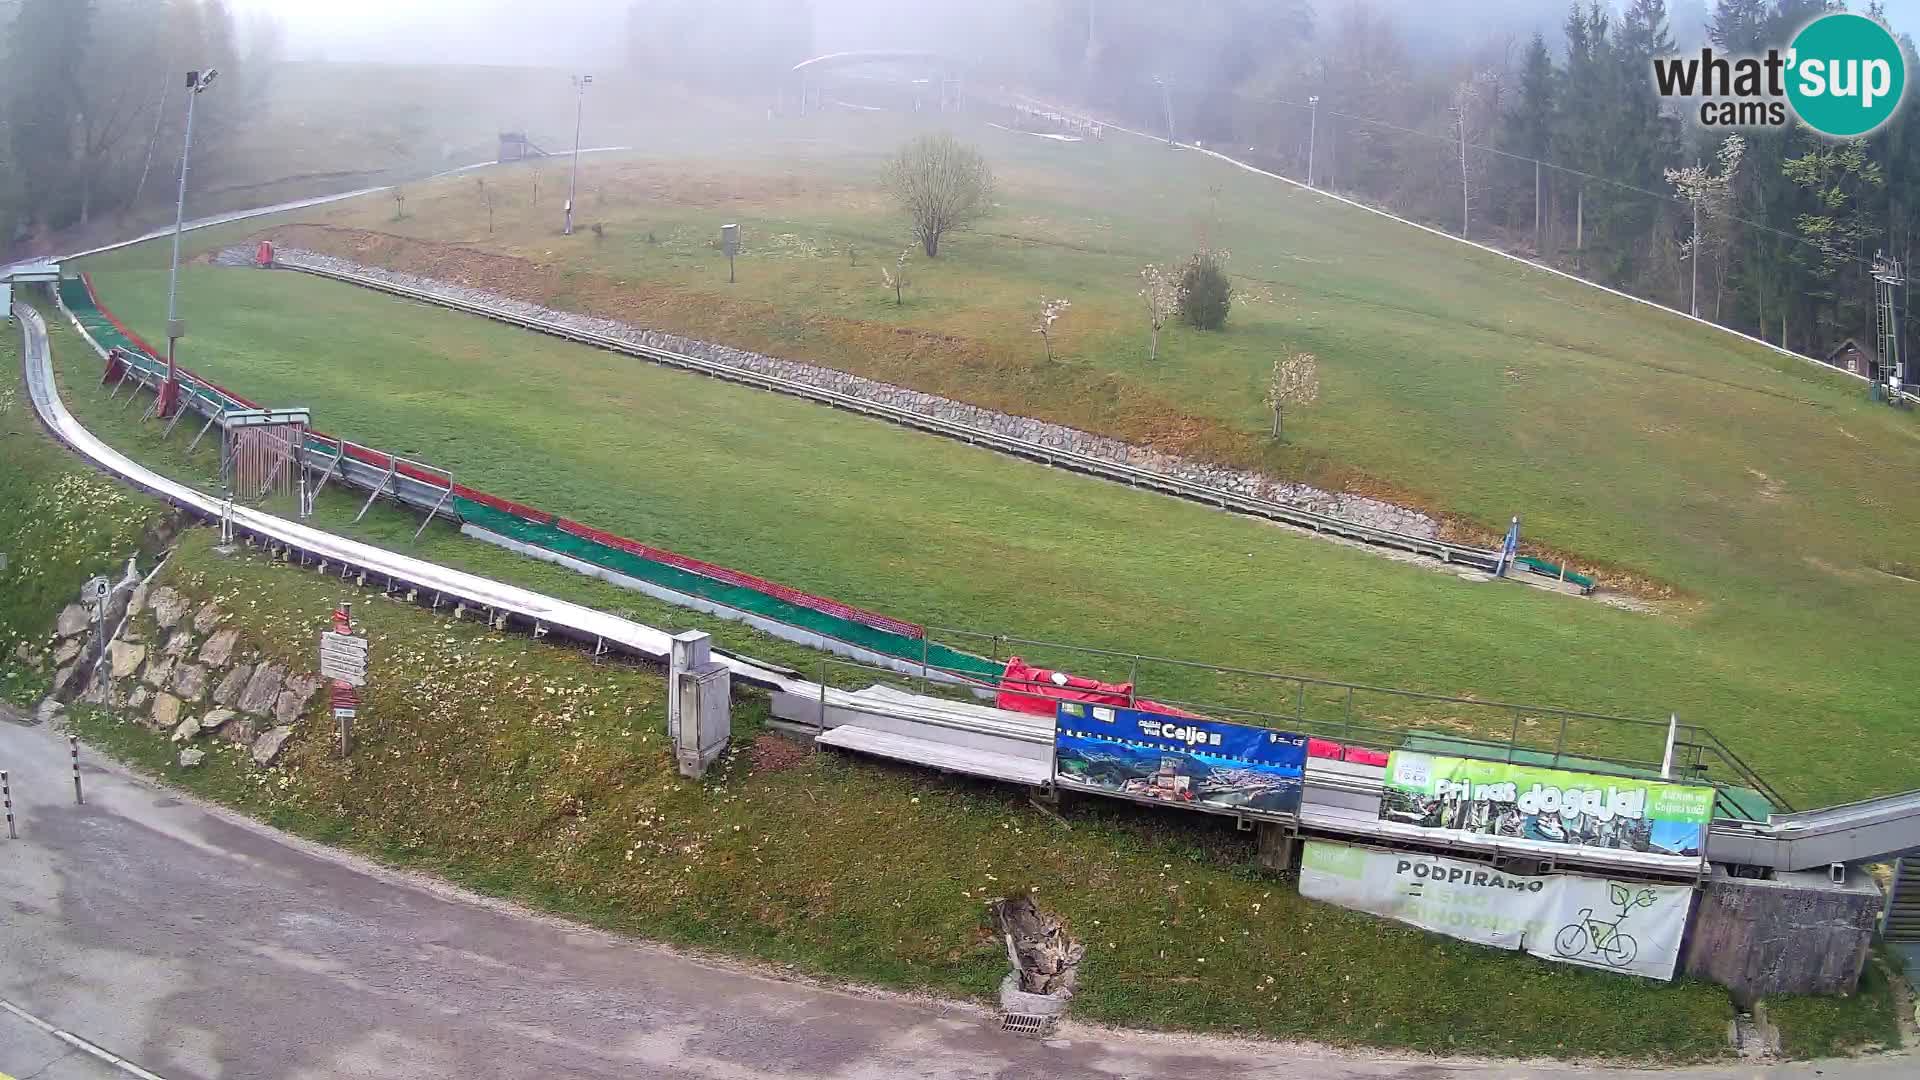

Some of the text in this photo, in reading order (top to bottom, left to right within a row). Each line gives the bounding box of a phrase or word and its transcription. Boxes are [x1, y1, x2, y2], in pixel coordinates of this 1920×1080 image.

[1162, 723, 1207, 745] Celje
[1434, 778, 1648, 822] Pri nas dogaja!
[1396, 858, 1544, 893] PODPIRAMO
